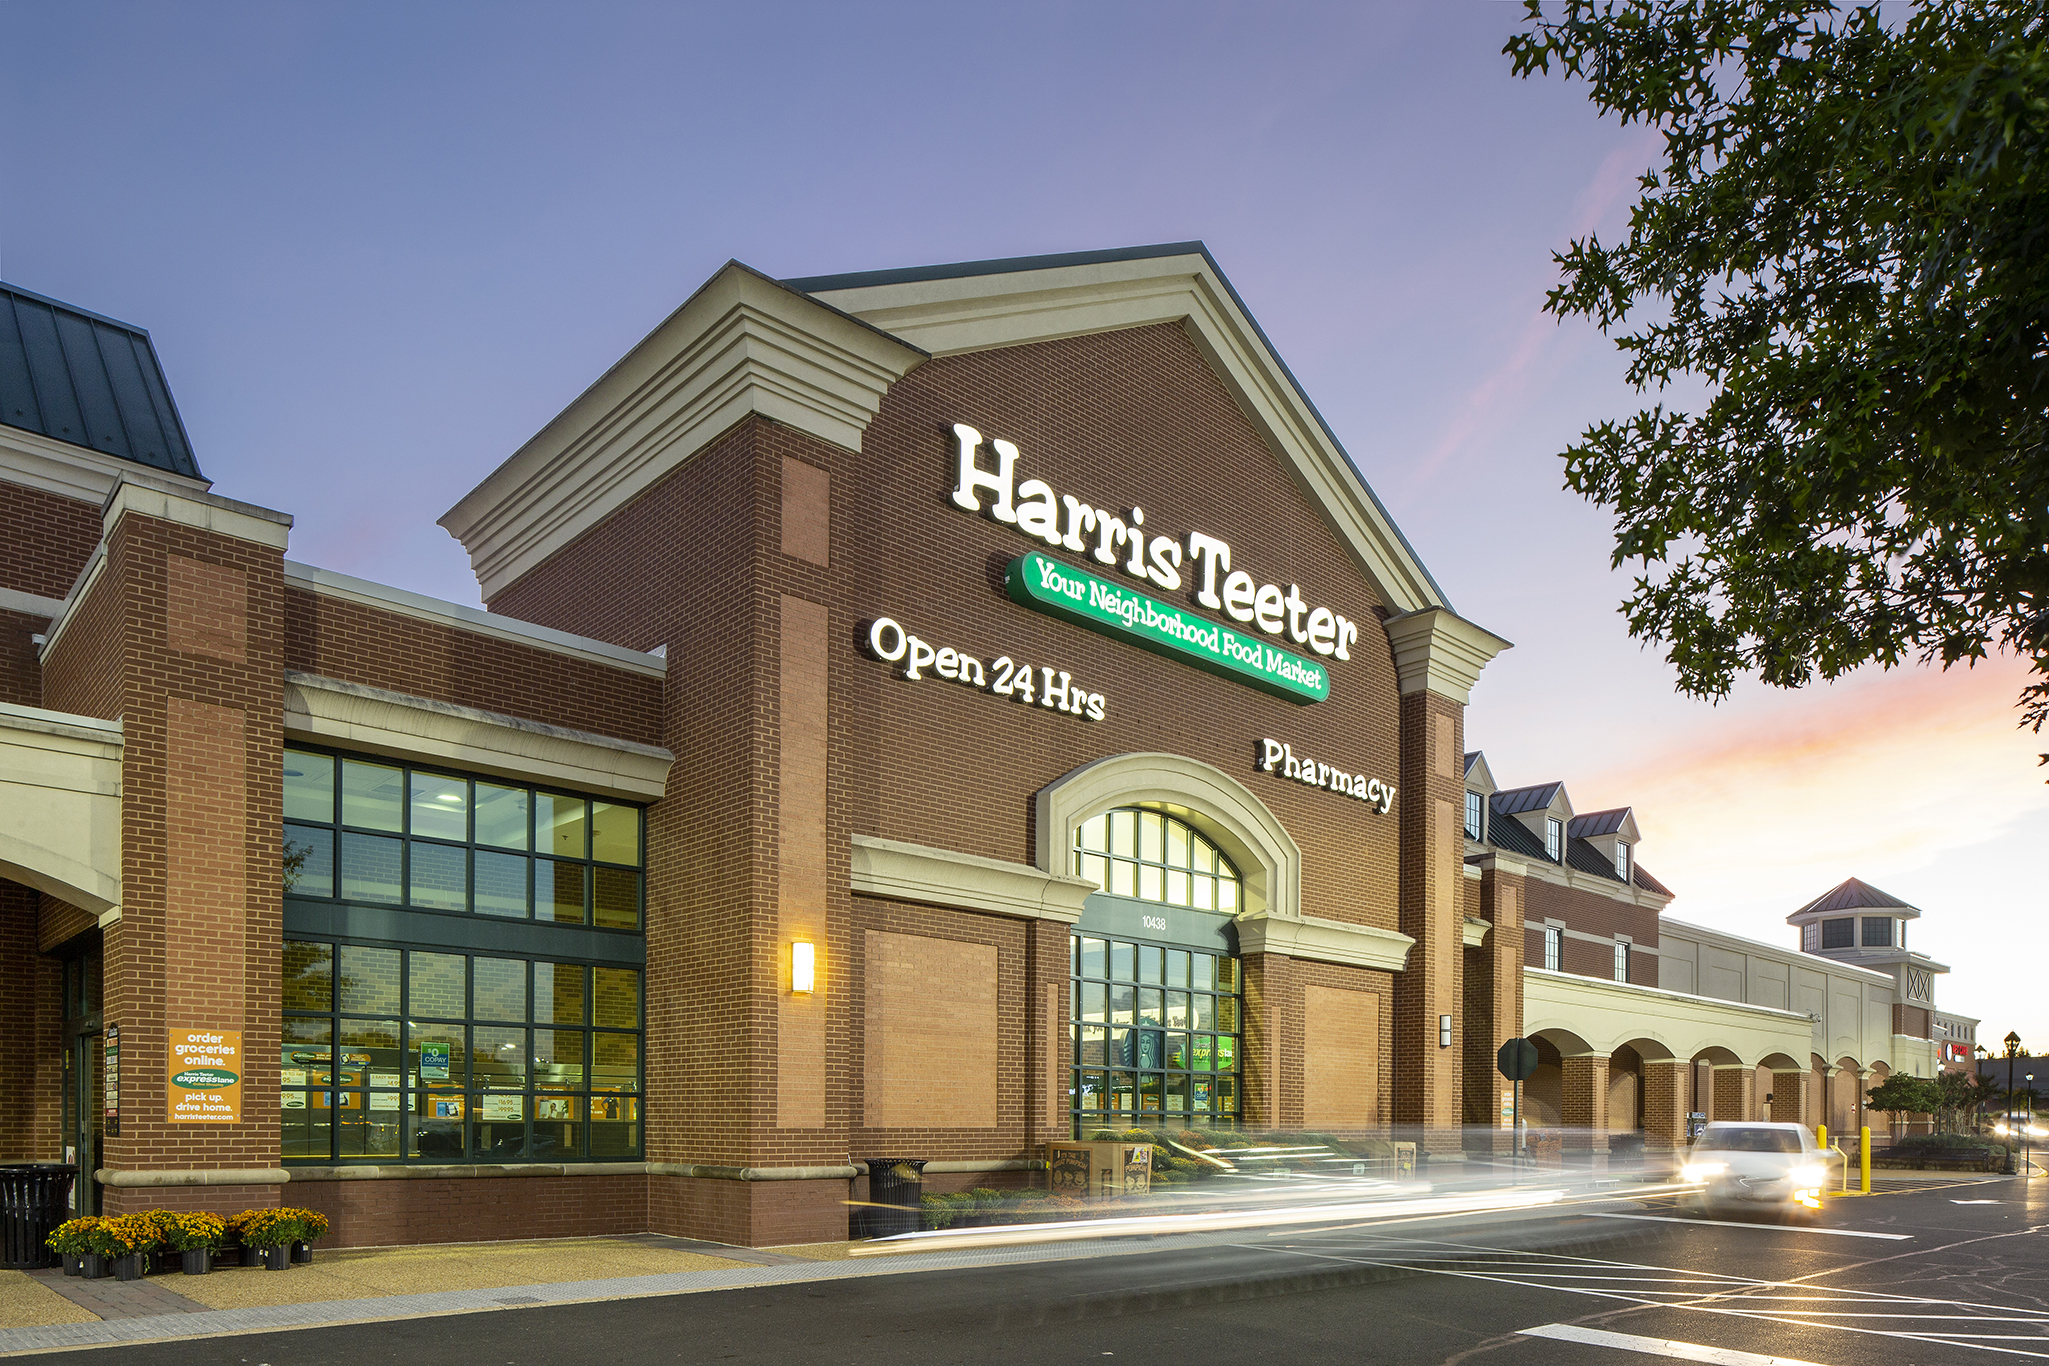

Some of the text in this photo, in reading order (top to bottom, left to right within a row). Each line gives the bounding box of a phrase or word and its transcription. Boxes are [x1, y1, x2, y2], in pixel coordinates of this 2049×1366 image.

[952, 423, 1358, 661] Harris Teeter
[1036, 557, 1322, 691] Your Neighborhood Food Market
[870, 617, 1106, 721] Open 24 Hrs
[1263, 737, 1397, 814] Pharmacy
[1142, 914, 1166, 931] 10438
[187, 1033, 224, 1043] order
[175, 1044, 236, 1056] groceries
[184, 1055, 226, 1066] online.
[185, 1092, 224, 1103] pick up.
[175, 1102, 233, 1111] drive home.
